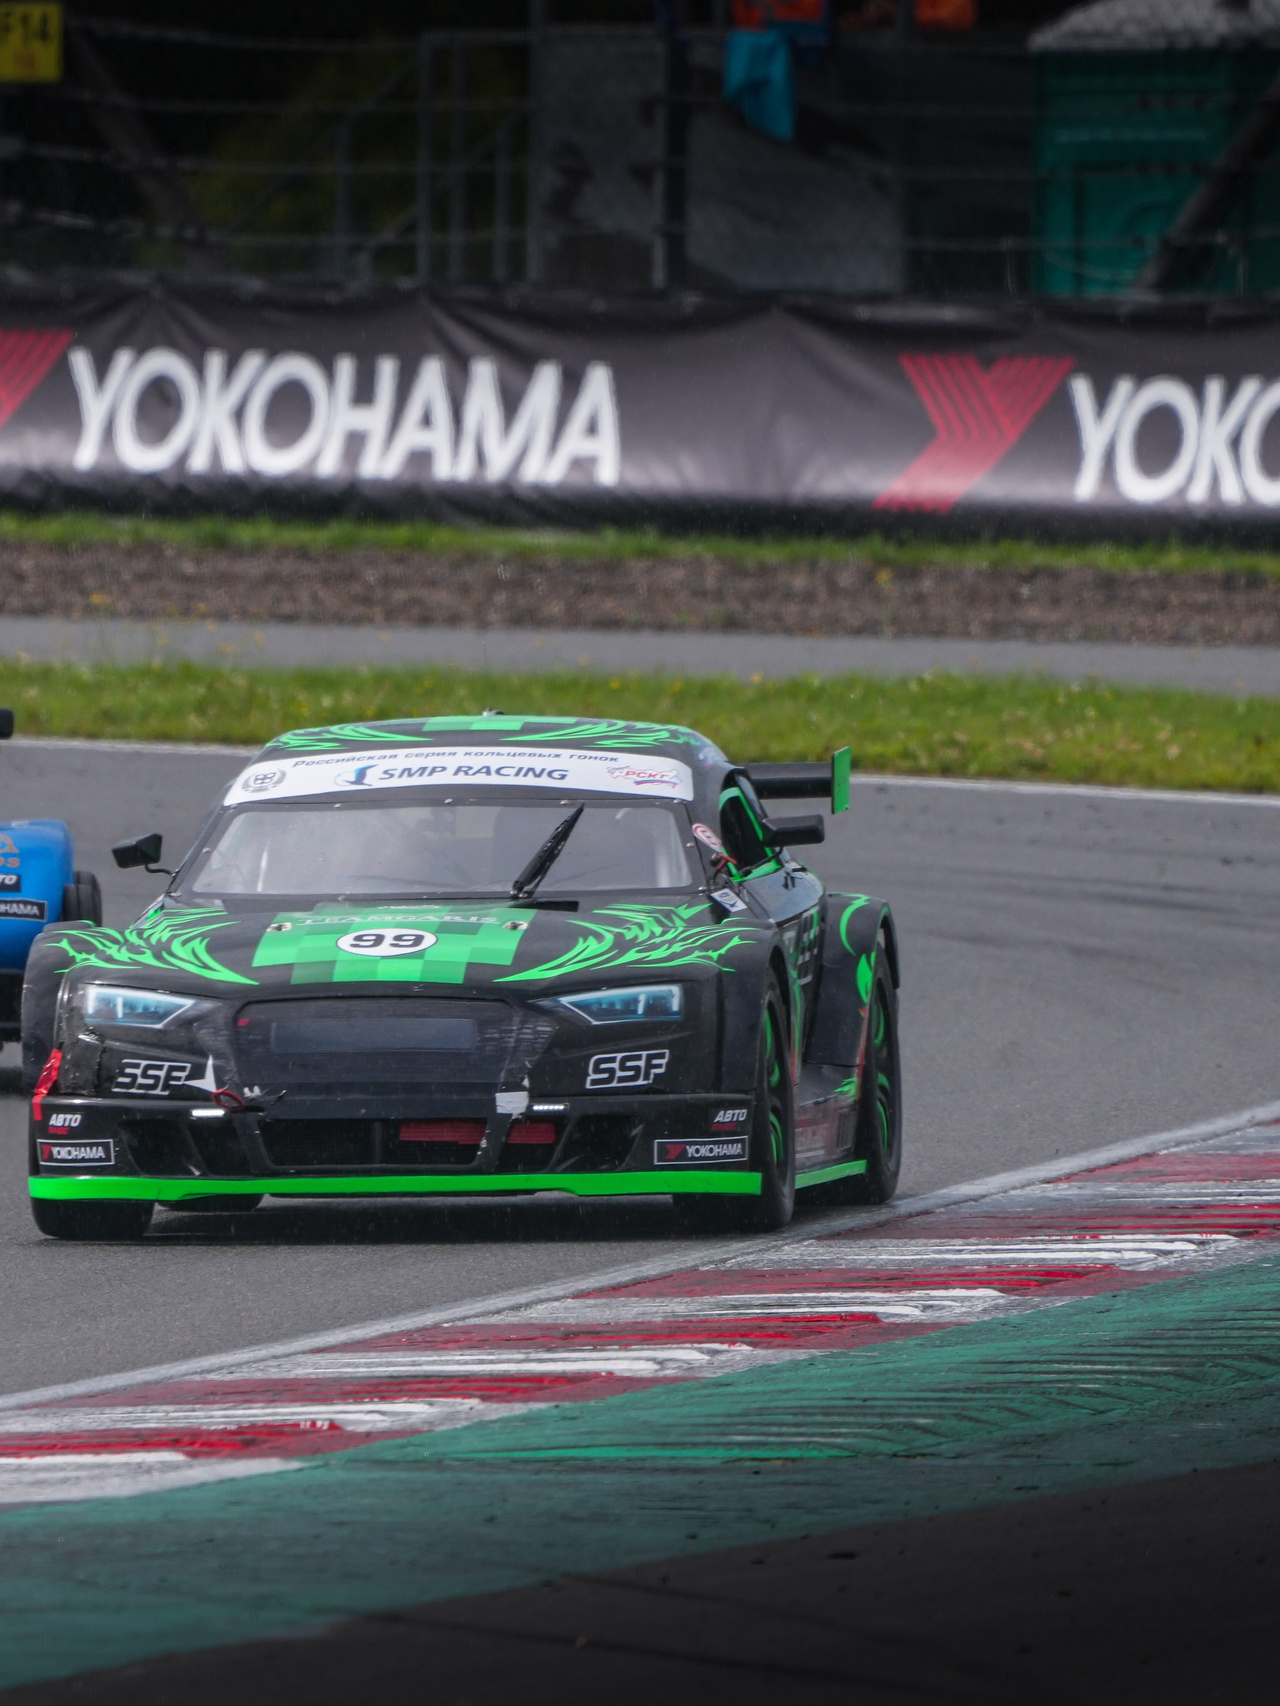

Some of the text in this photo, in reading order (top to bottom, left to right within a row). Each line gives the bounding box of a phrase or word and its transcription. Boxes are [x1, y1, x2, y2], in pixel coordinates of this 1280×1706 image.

[68, 345, 621, 487] YOKOHAMA
[292, 750, 620, 768] Российская серия кольцевых гонок
[379, 764, 569, 781] SMP RACING
[624, 769, 670, 780] РСКГ
[349, 933, 425, 949] 99
[112, 1058, 192, 1095] SSF
[585, 1049, 669, 1089] SSF
[49, 1113, 82, 1127] АВТО
[714, 1109, 748, 1122] АВТО
[50, 1145, 106, 1160] YOKOHAMA
[686, 1142, 743, 1158] YOKOHAMA
